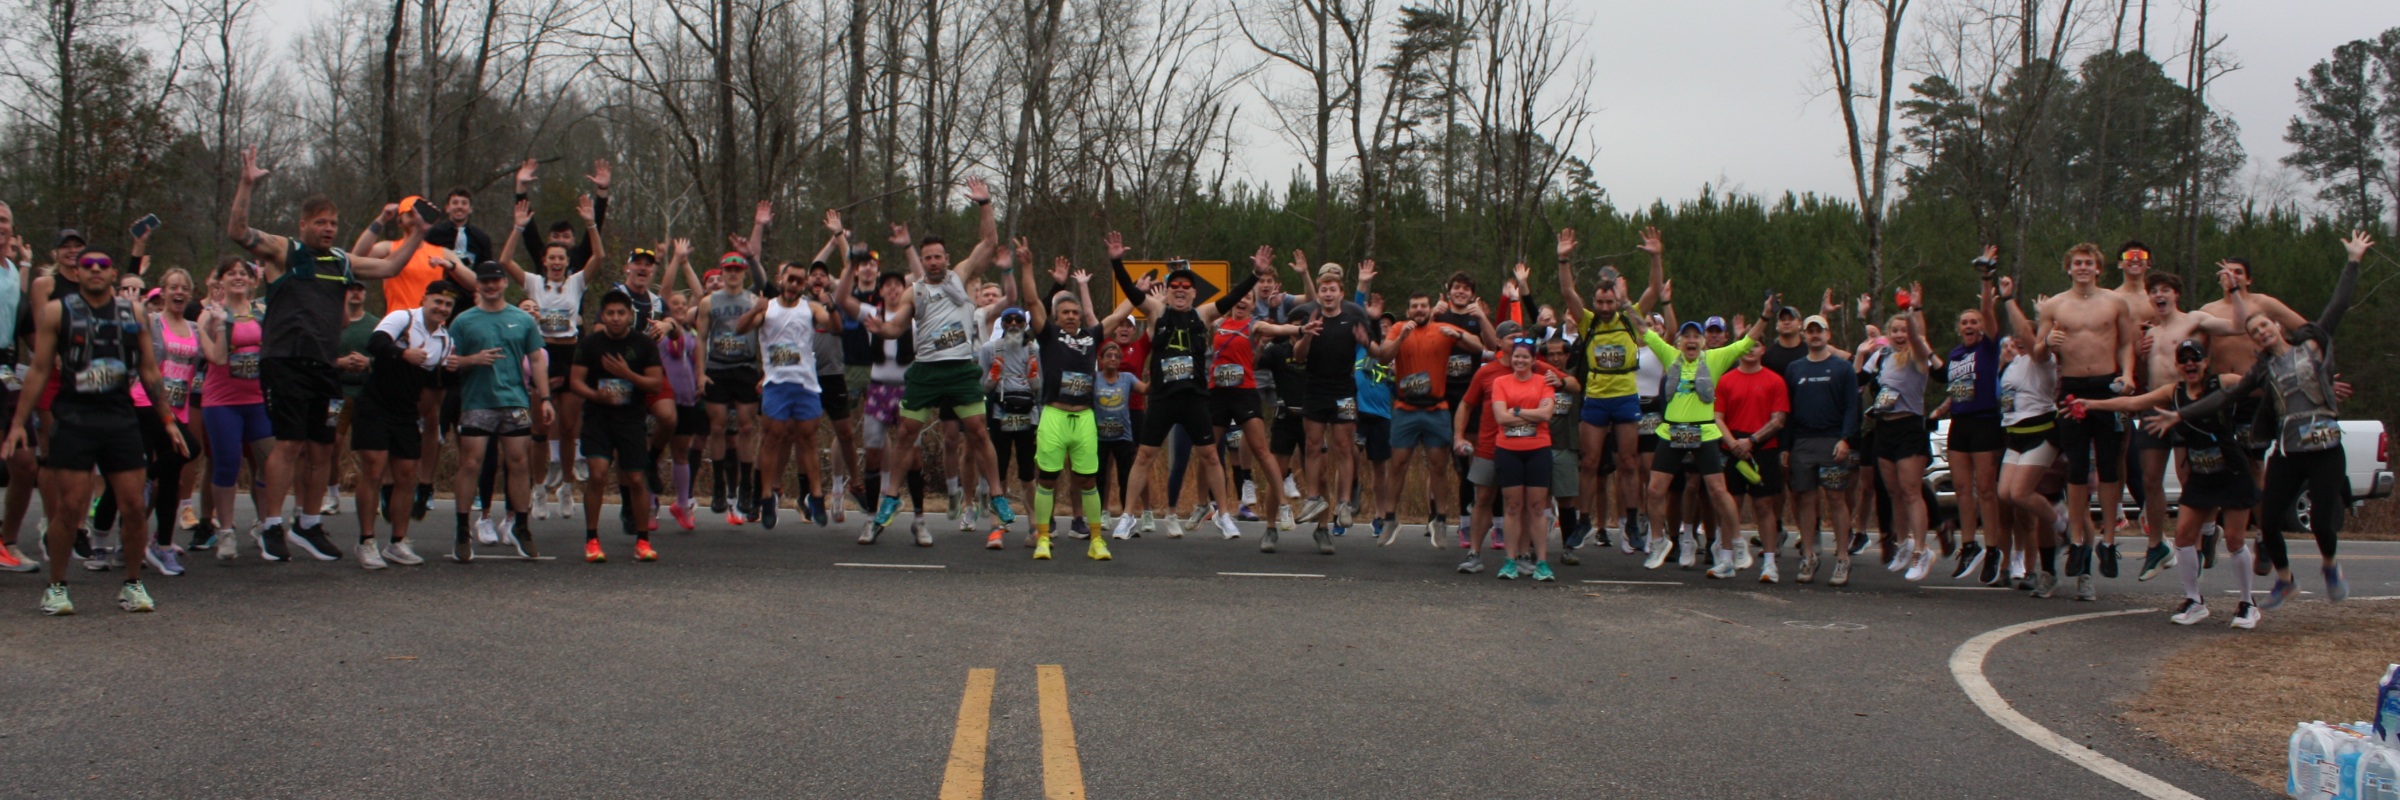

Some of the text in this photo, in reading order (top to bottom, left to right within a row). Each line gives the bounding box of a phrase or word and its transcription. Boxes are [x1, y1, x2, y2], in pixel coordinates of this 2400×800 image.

[940, 330, 959, 346] 845
[1601, 351, 1619, 364] 948
[1219, 370, 1237, 382] 846
[1069, 379, 1086, 392] 792
[1007, 415, 1025, 427] 915
[2311, 428, 2334, 446] 641
